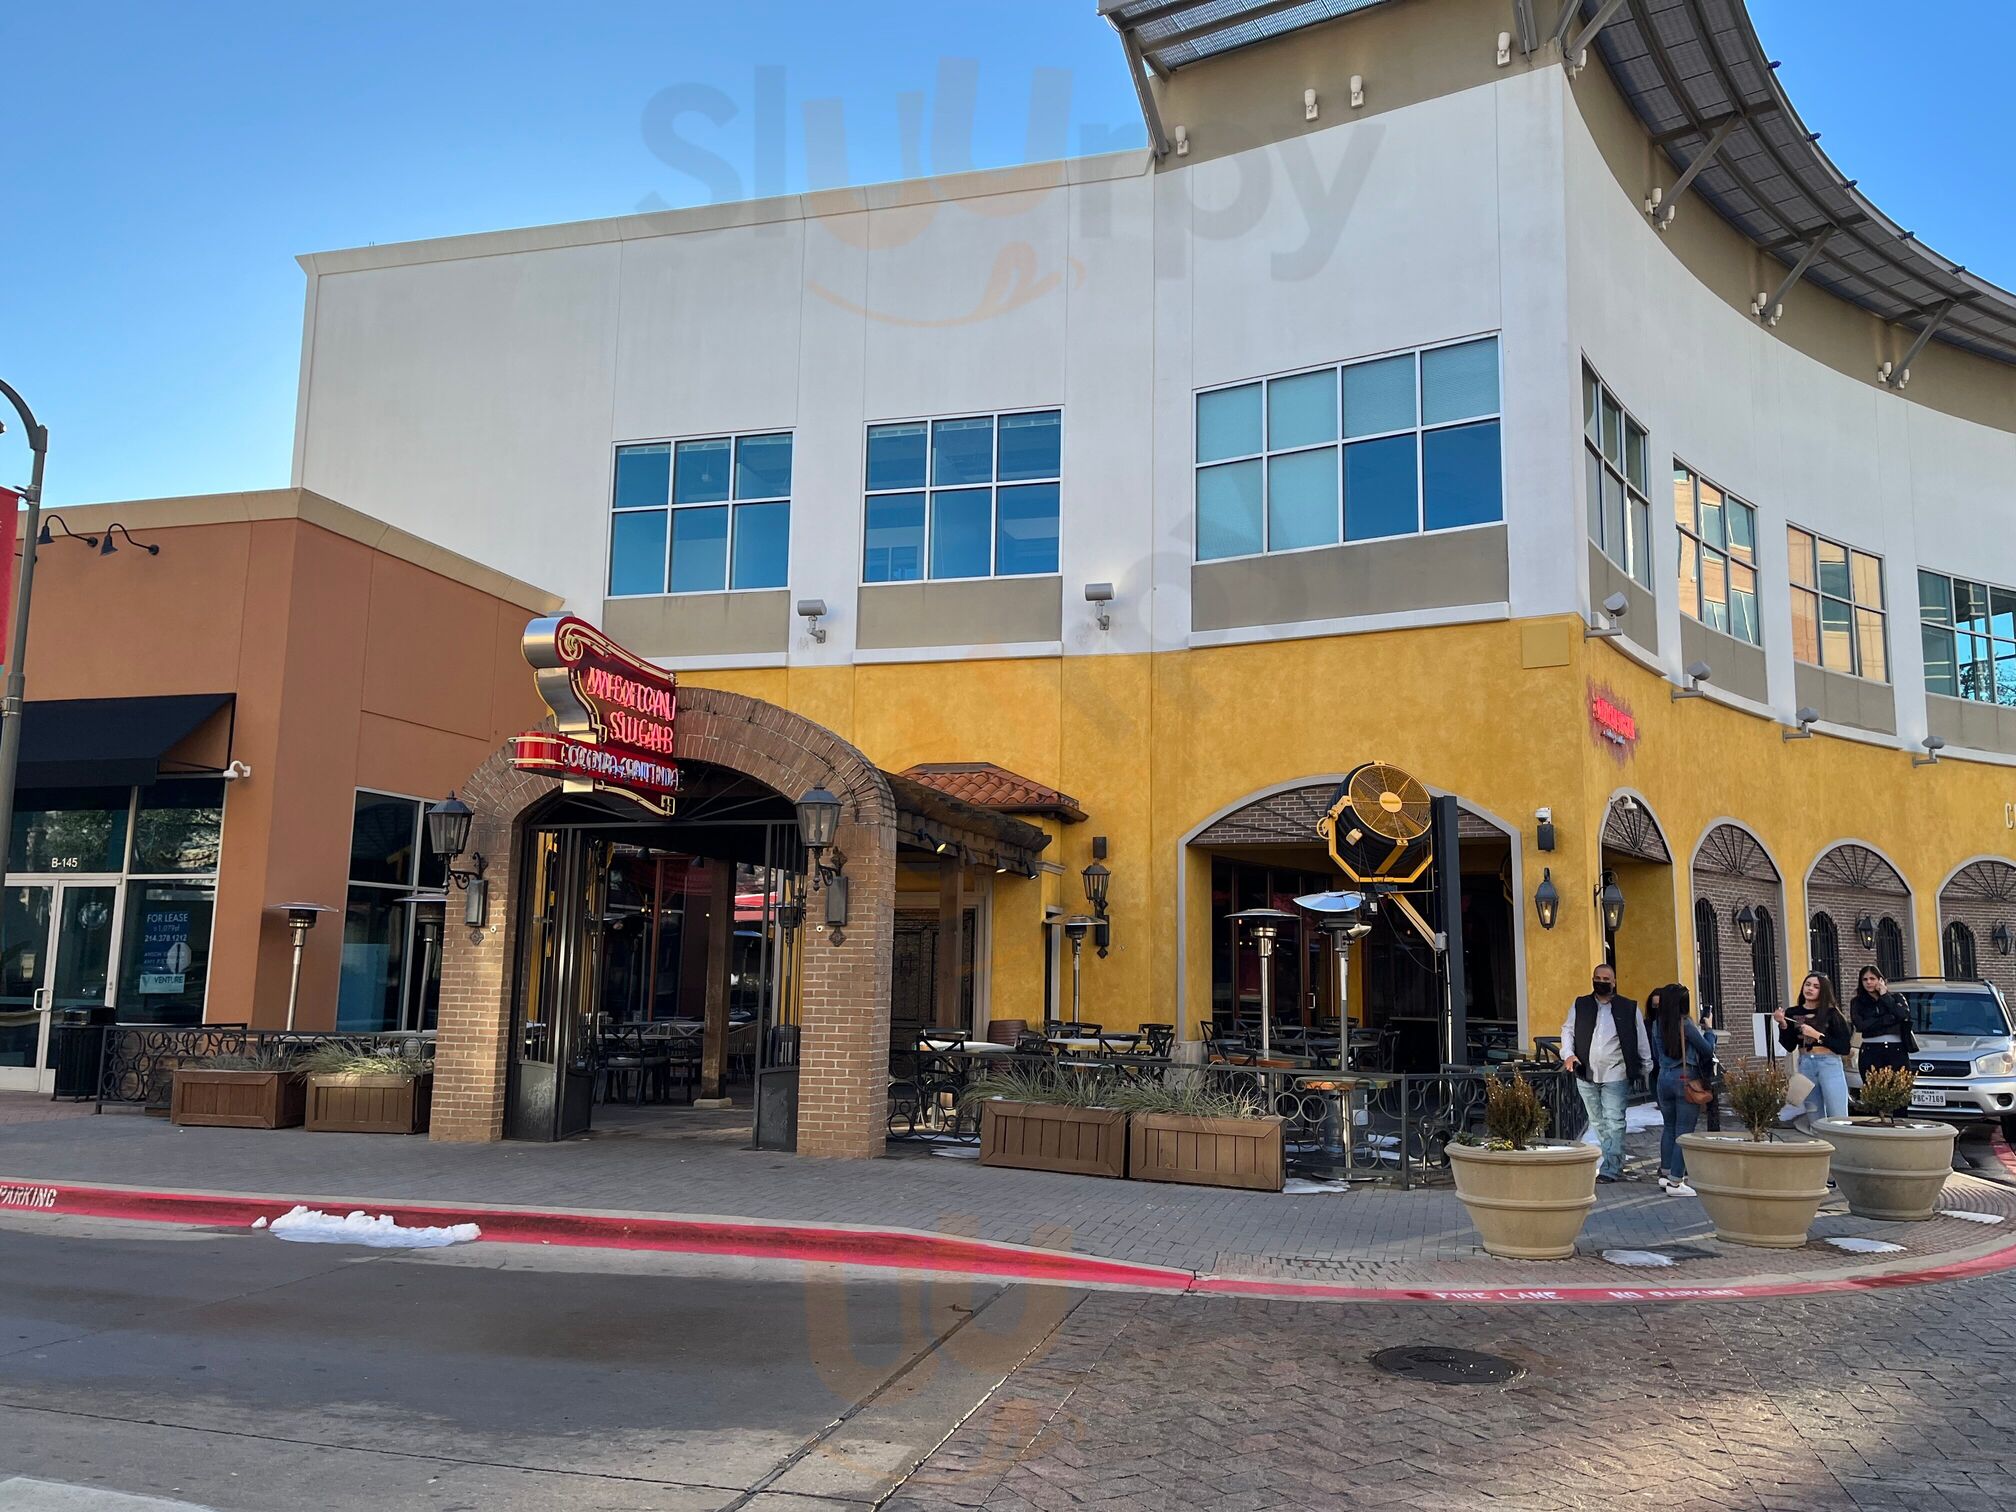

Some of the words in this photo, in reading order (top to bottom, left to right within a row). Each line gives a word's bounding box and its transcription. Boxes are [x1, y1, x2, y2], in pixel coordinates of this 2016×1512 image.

[609, 711, 674, 753] SUGAR
[51, 857, 78, 868] B-145
[147, 913, 163, 923] FOR
[164, 912, 189, 922] LEASE
[154, 976, 184, 984] VENTURE
[0, 1184, 57, 1207] PARKING
[1434, 1291, 1491, 1300] FIRE
[1498, 1290, 1564, 1300] LANE
